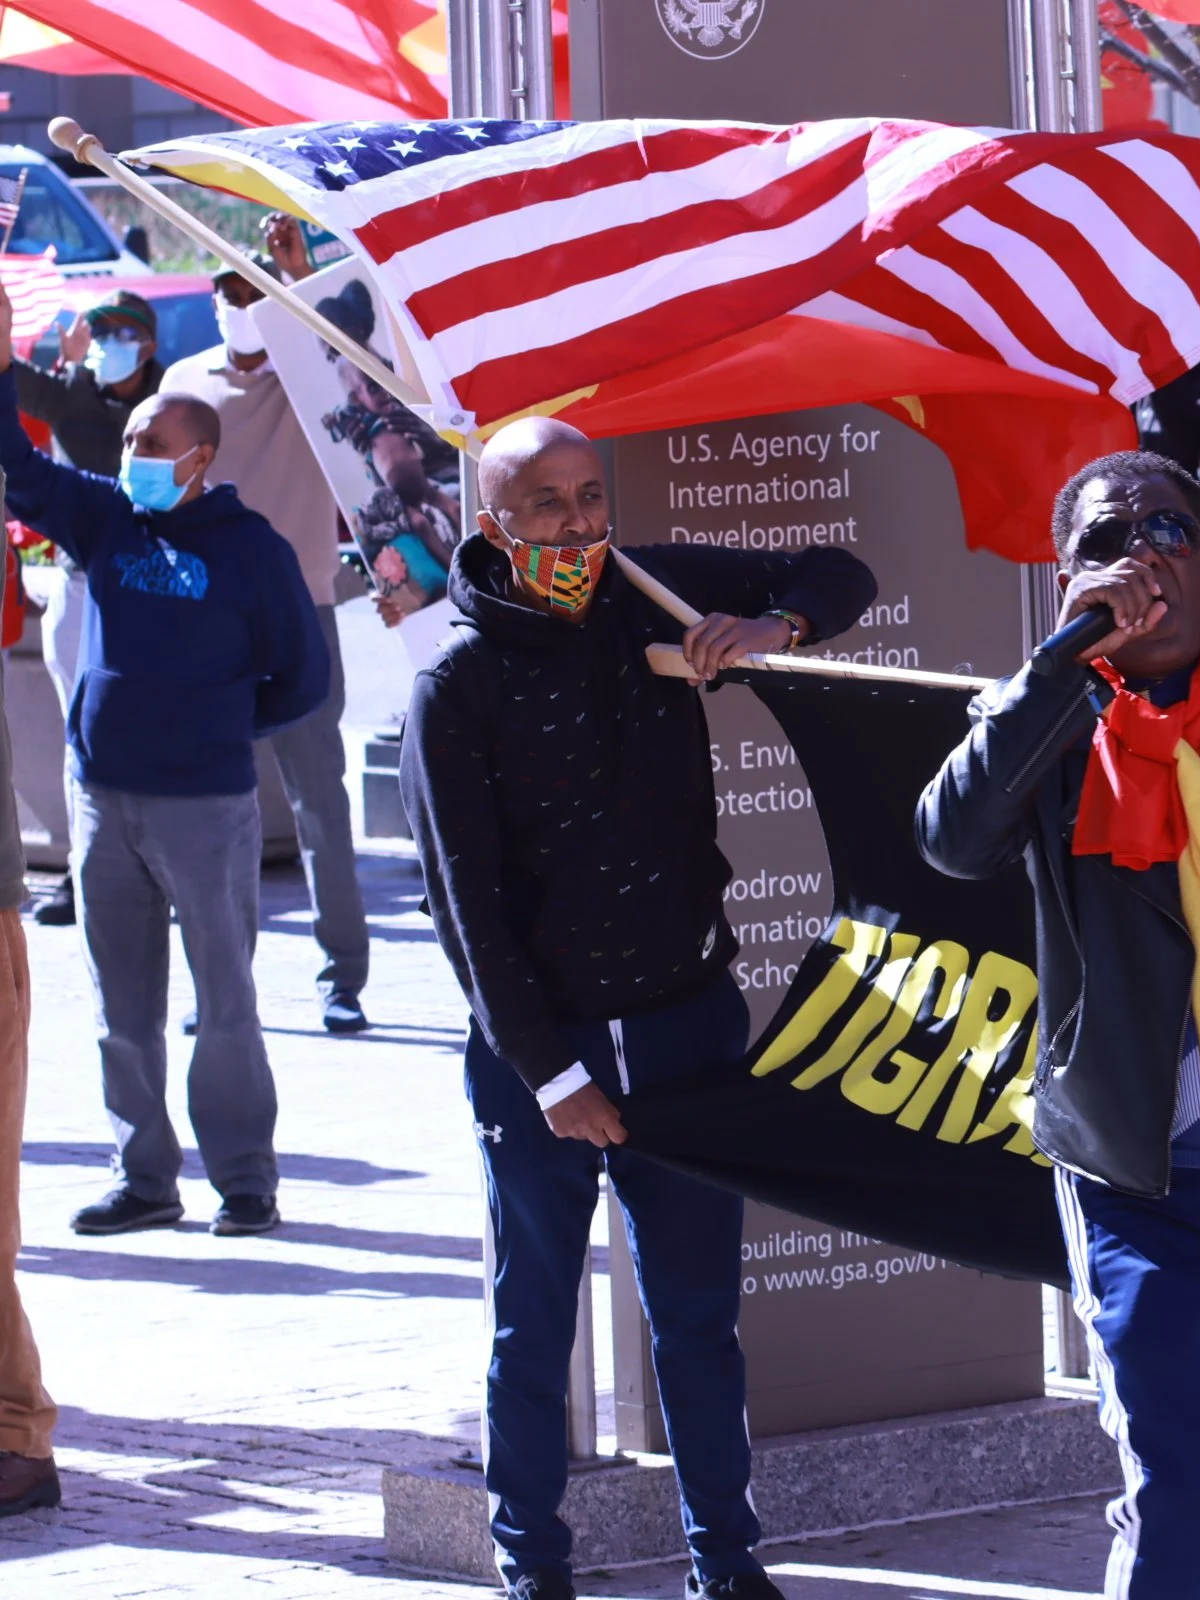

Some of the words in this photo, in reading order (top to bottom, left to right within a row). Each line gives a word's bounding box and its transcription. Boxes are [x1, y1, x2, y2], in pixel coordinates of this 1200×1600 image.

[668, 434, 719, 464] U.S.
[729, 432, 832, 467] Agency
[840, 423, 880, 452] for
[669, 468, 850, 509] International
[670, 517, 858, 551] Development
[859, 594, 909, 628] and
[731, 911, 831, 945] rnatio
[736, 953, 806, 991] Scho
[750, 916, 1055, 1168] TIGRA
[740, 1276, 757, 1295] o
